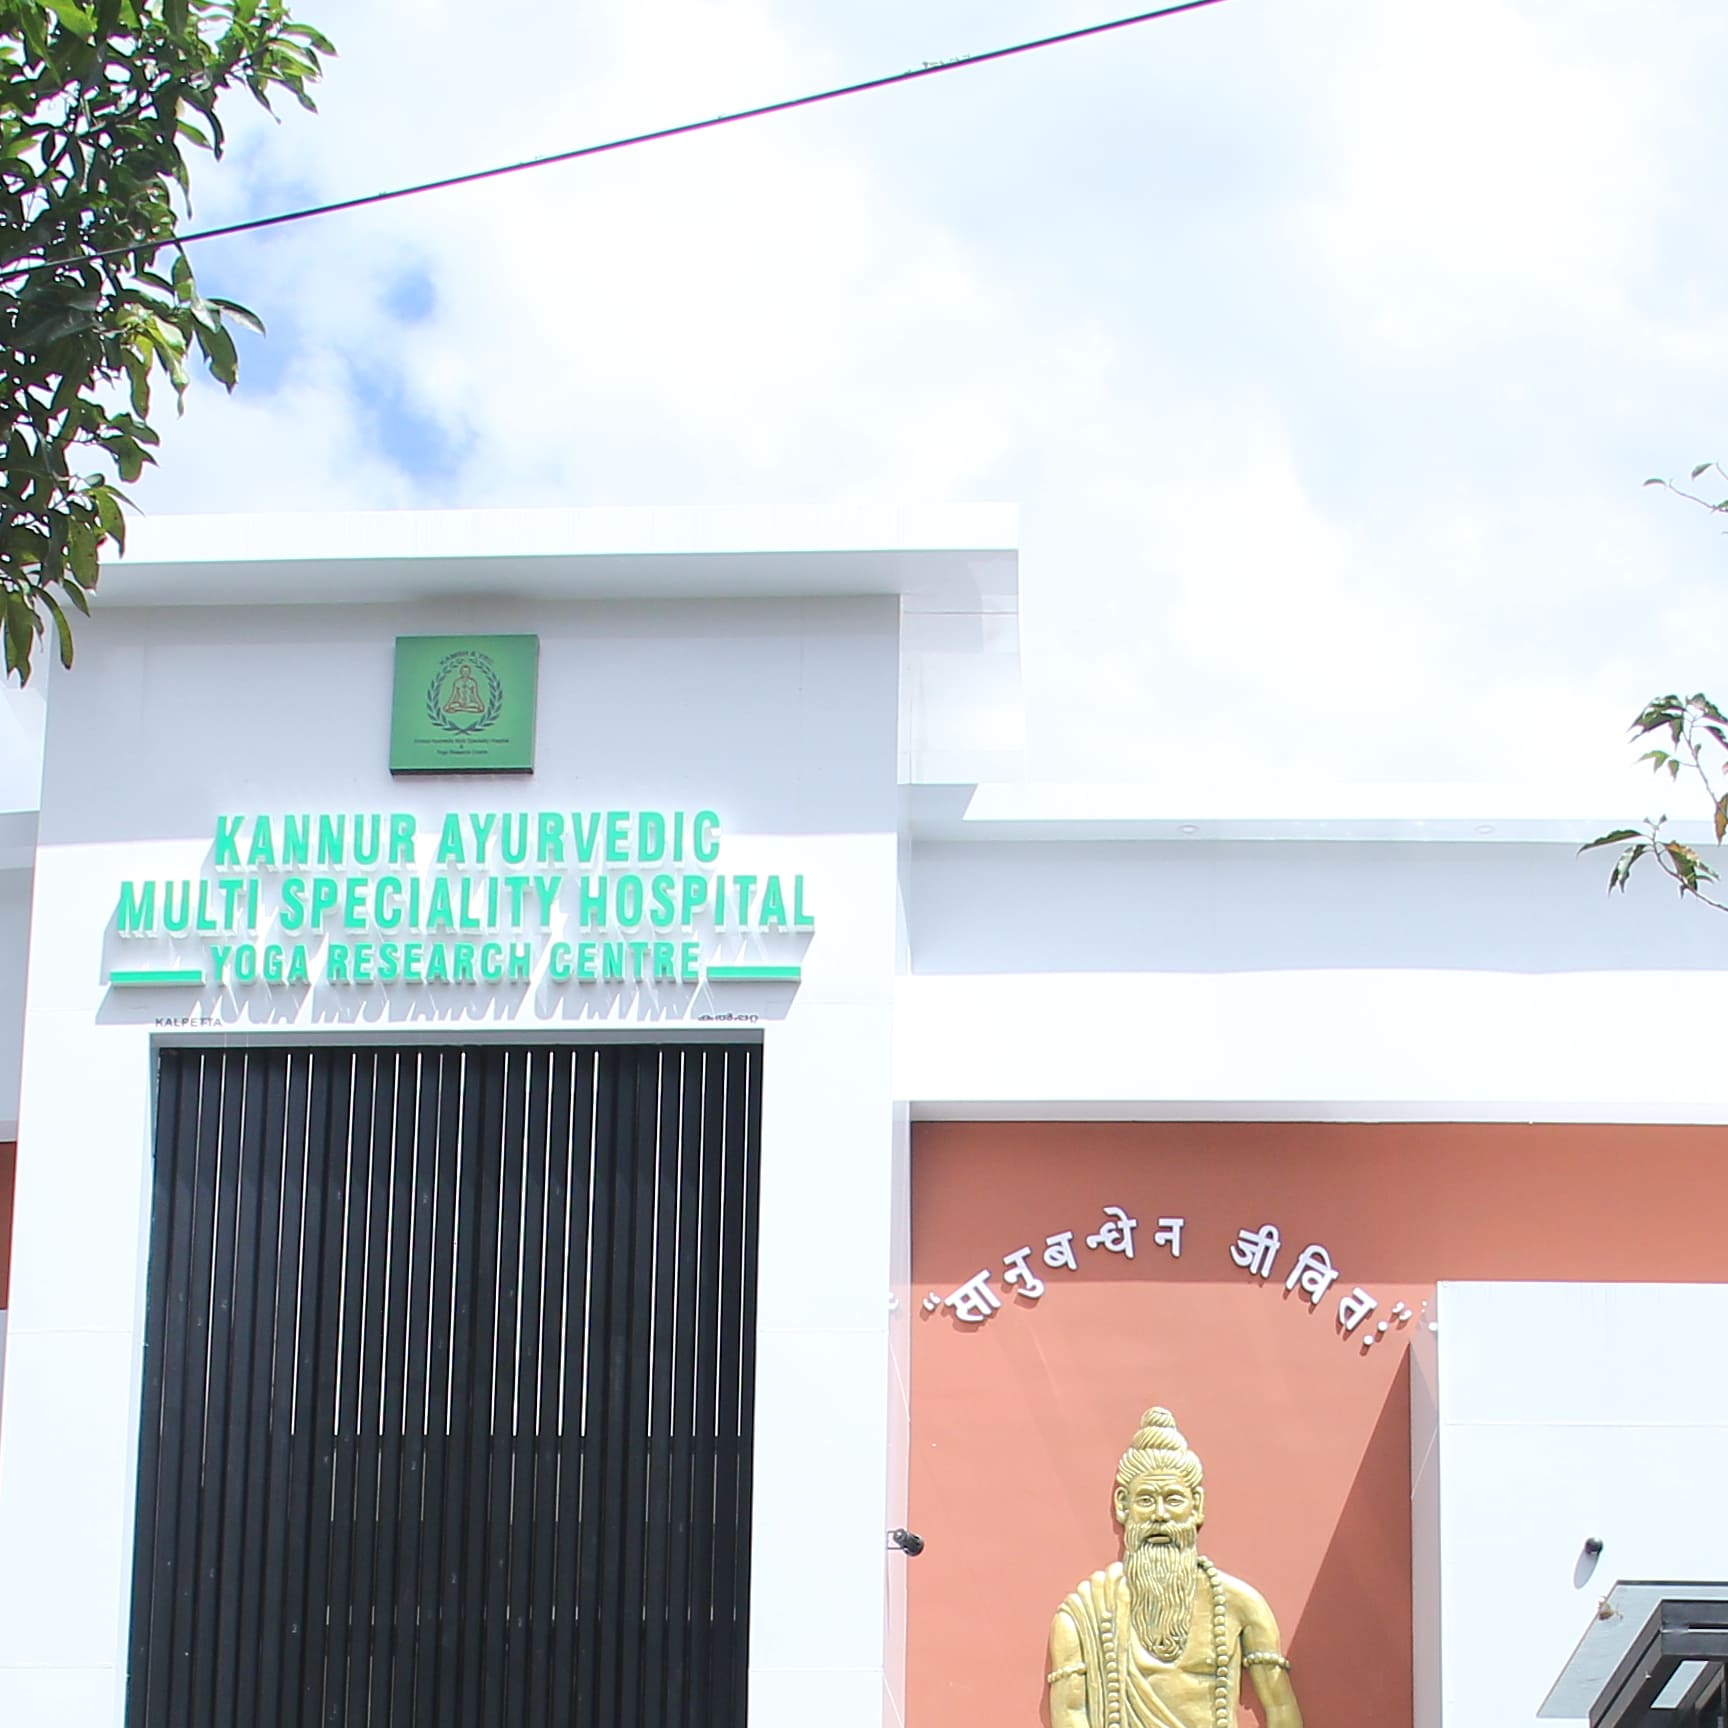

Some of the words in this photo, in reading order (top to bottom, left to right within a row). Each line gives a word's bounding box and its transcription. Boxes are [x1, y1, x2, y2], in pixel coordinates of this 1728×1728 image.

[214, 812, 417, 866] KANNUR
[436, 809, 722, 864] AYURVEDIC
[116, 879, 260, 932] MULTI
[279, 874, 563, 931] SPECIALITY
[579, 873, 815, 928] HOSPITAL
[209, 943, 309, 982] YOGA
[325, 941, 532, 981] RESEARCH
[548, 940, 700, 980] CENTRE
[154, 1017, 223, 1028] KALPETTA
